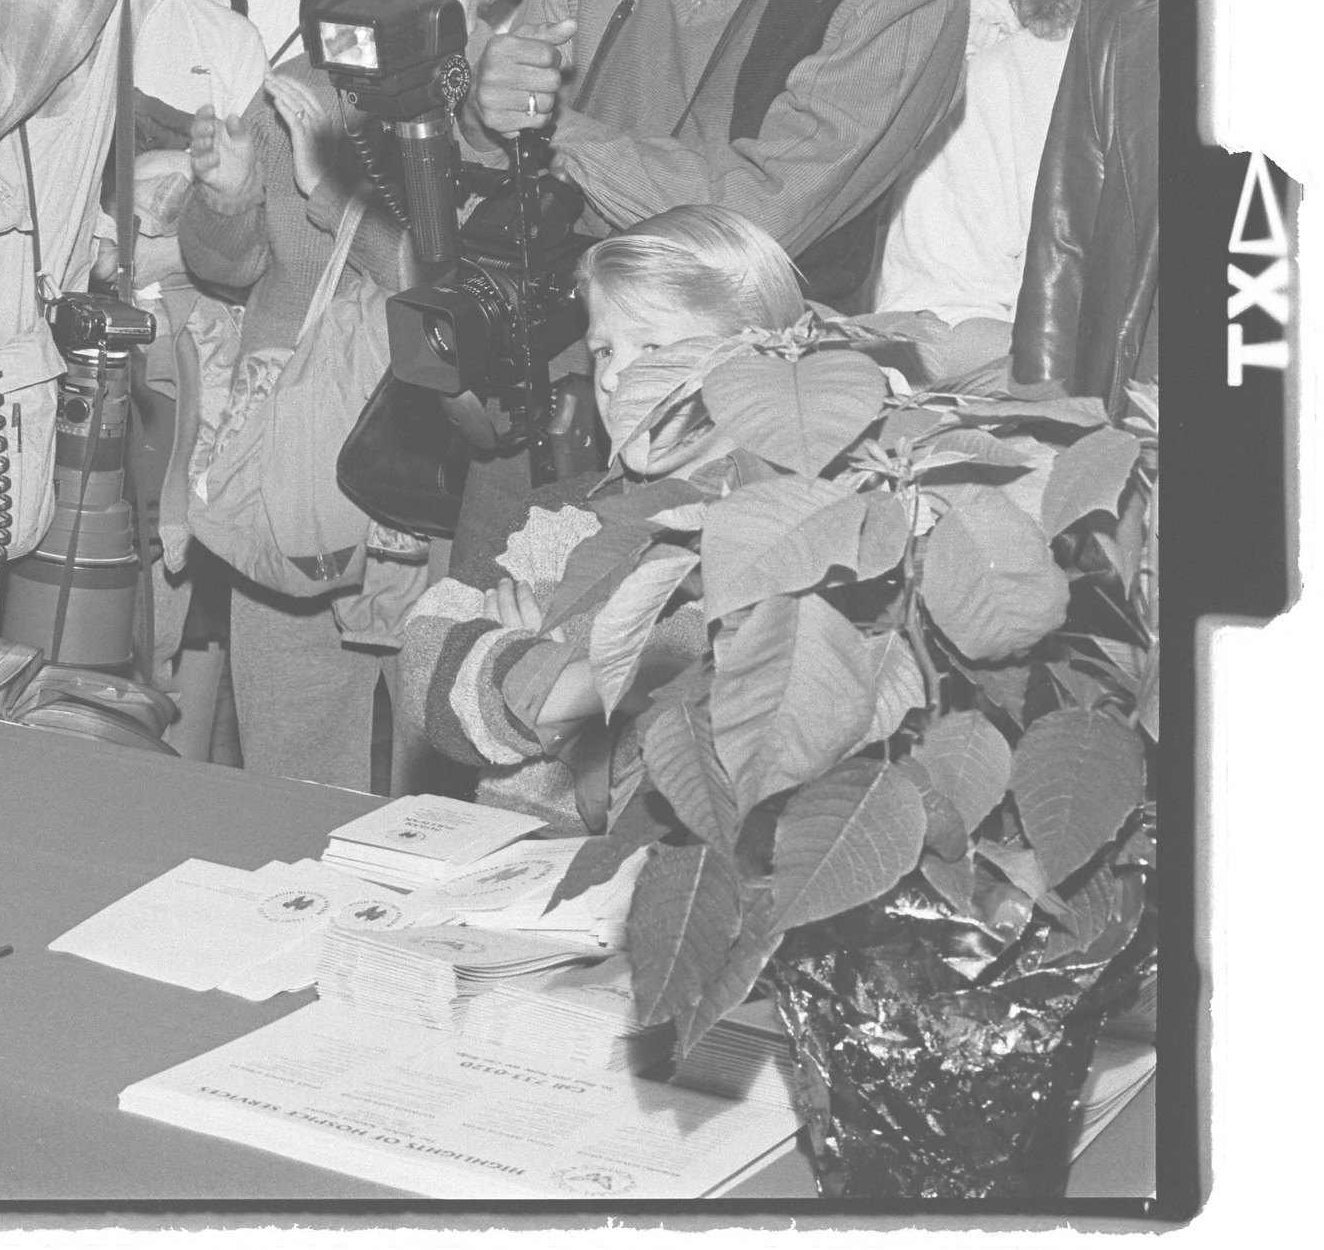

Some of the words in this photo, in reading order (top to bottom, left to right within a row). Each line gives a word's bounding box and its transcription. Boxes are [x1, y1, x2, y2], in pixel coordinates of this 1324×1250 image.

[1227, 263, 1289, 387] TX
[197, 1085, 282, 1112] SERVICES
[552, 1082, 586, 1093] Call
[288, 1110, 369, 1137] HOSPICE
[371, 1134, 402, 1145] OF
[404, 1141, 526, 1177] HIGHLIGHTS
